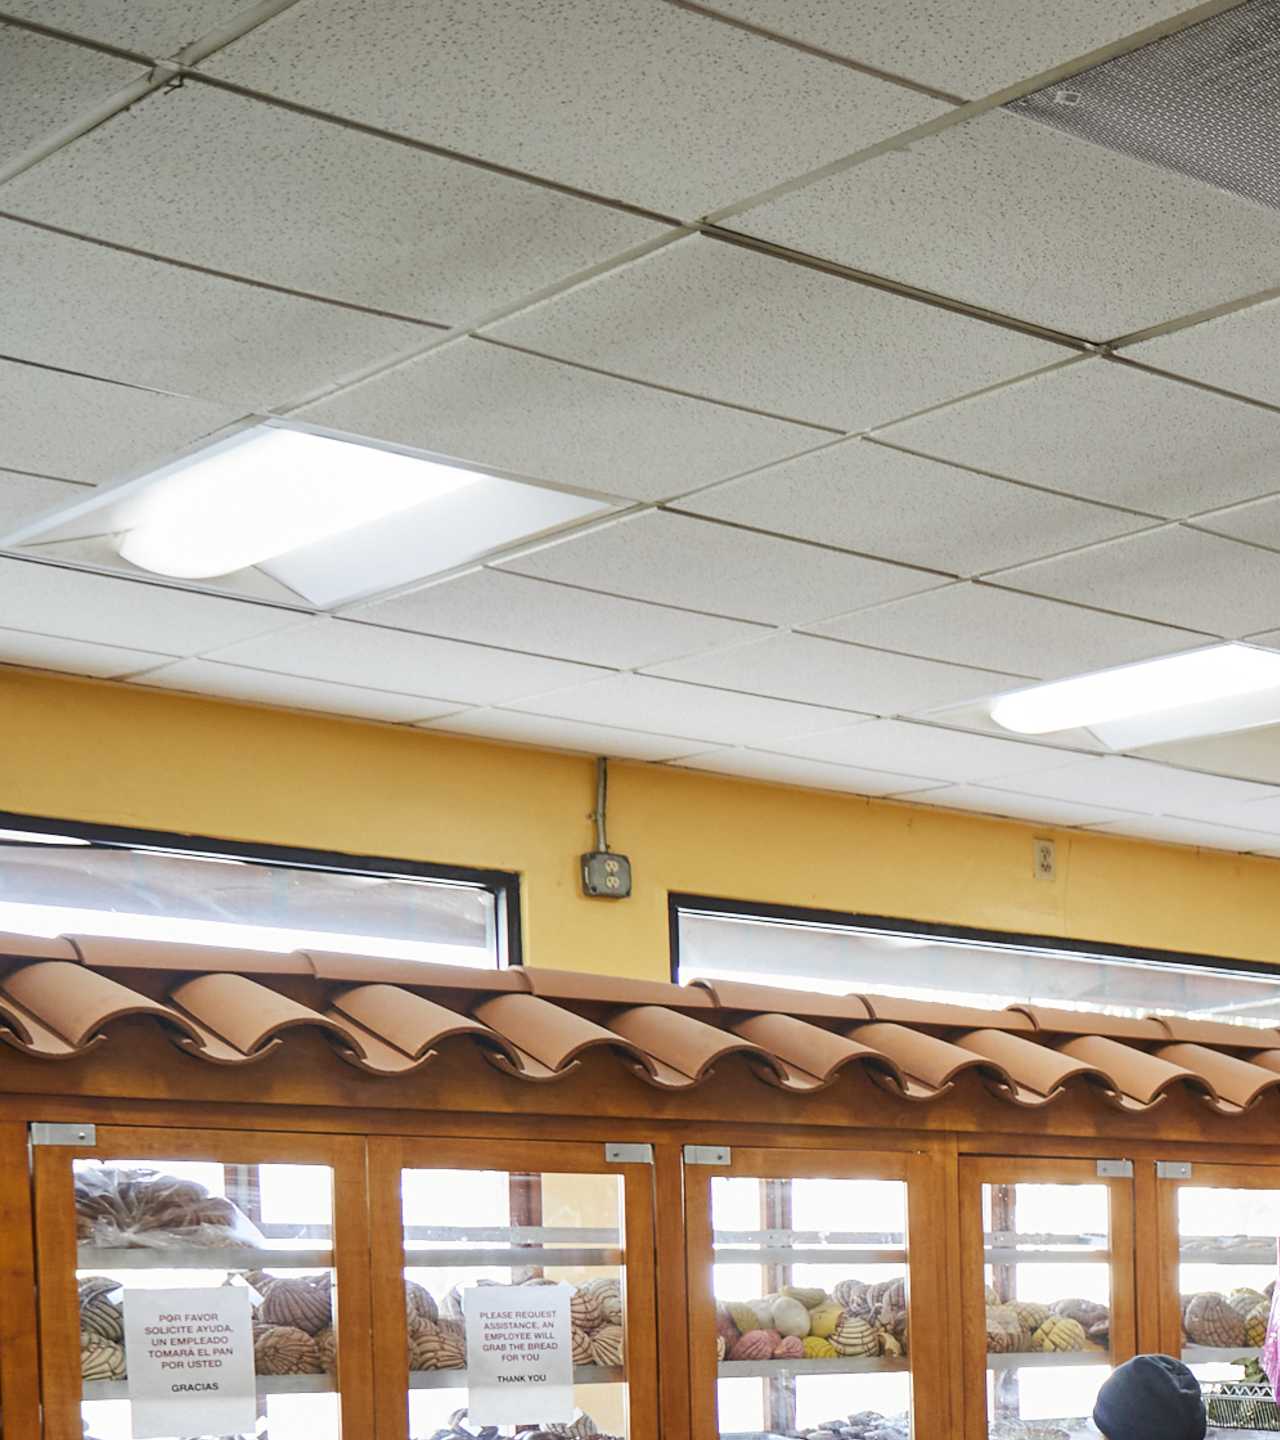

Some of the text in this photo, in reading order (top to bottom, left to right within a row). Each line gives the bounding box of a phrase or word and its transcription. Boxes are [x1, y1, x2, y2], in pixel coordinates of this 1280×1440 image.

[159, 1312, 218, 1322] POR FAVOR
[480, 1310, 556, 1320] PLEASE REQUEST
[144, 1325, 193, 1335] SOLICITE
[542, 1321, 554, 1329] AN
[152, 1336, 229, 1346] UN EMPLEADO
[484, 1331, 554, 1341] EMPLOYEE WILL
[198, 1348, 209, 1357] EL
[212, 1347, 233, 1356] PAN
[482, 1342, 558, 1352] GRAB THE BREAD
[501, 1353, 540, 1362] FOR YOU
[161, 1359, 222, 1370] POR USTED
[497, 1374, 546, 1383] THANK YOU
[171, 1382, 219, 1393] GRACIAS
